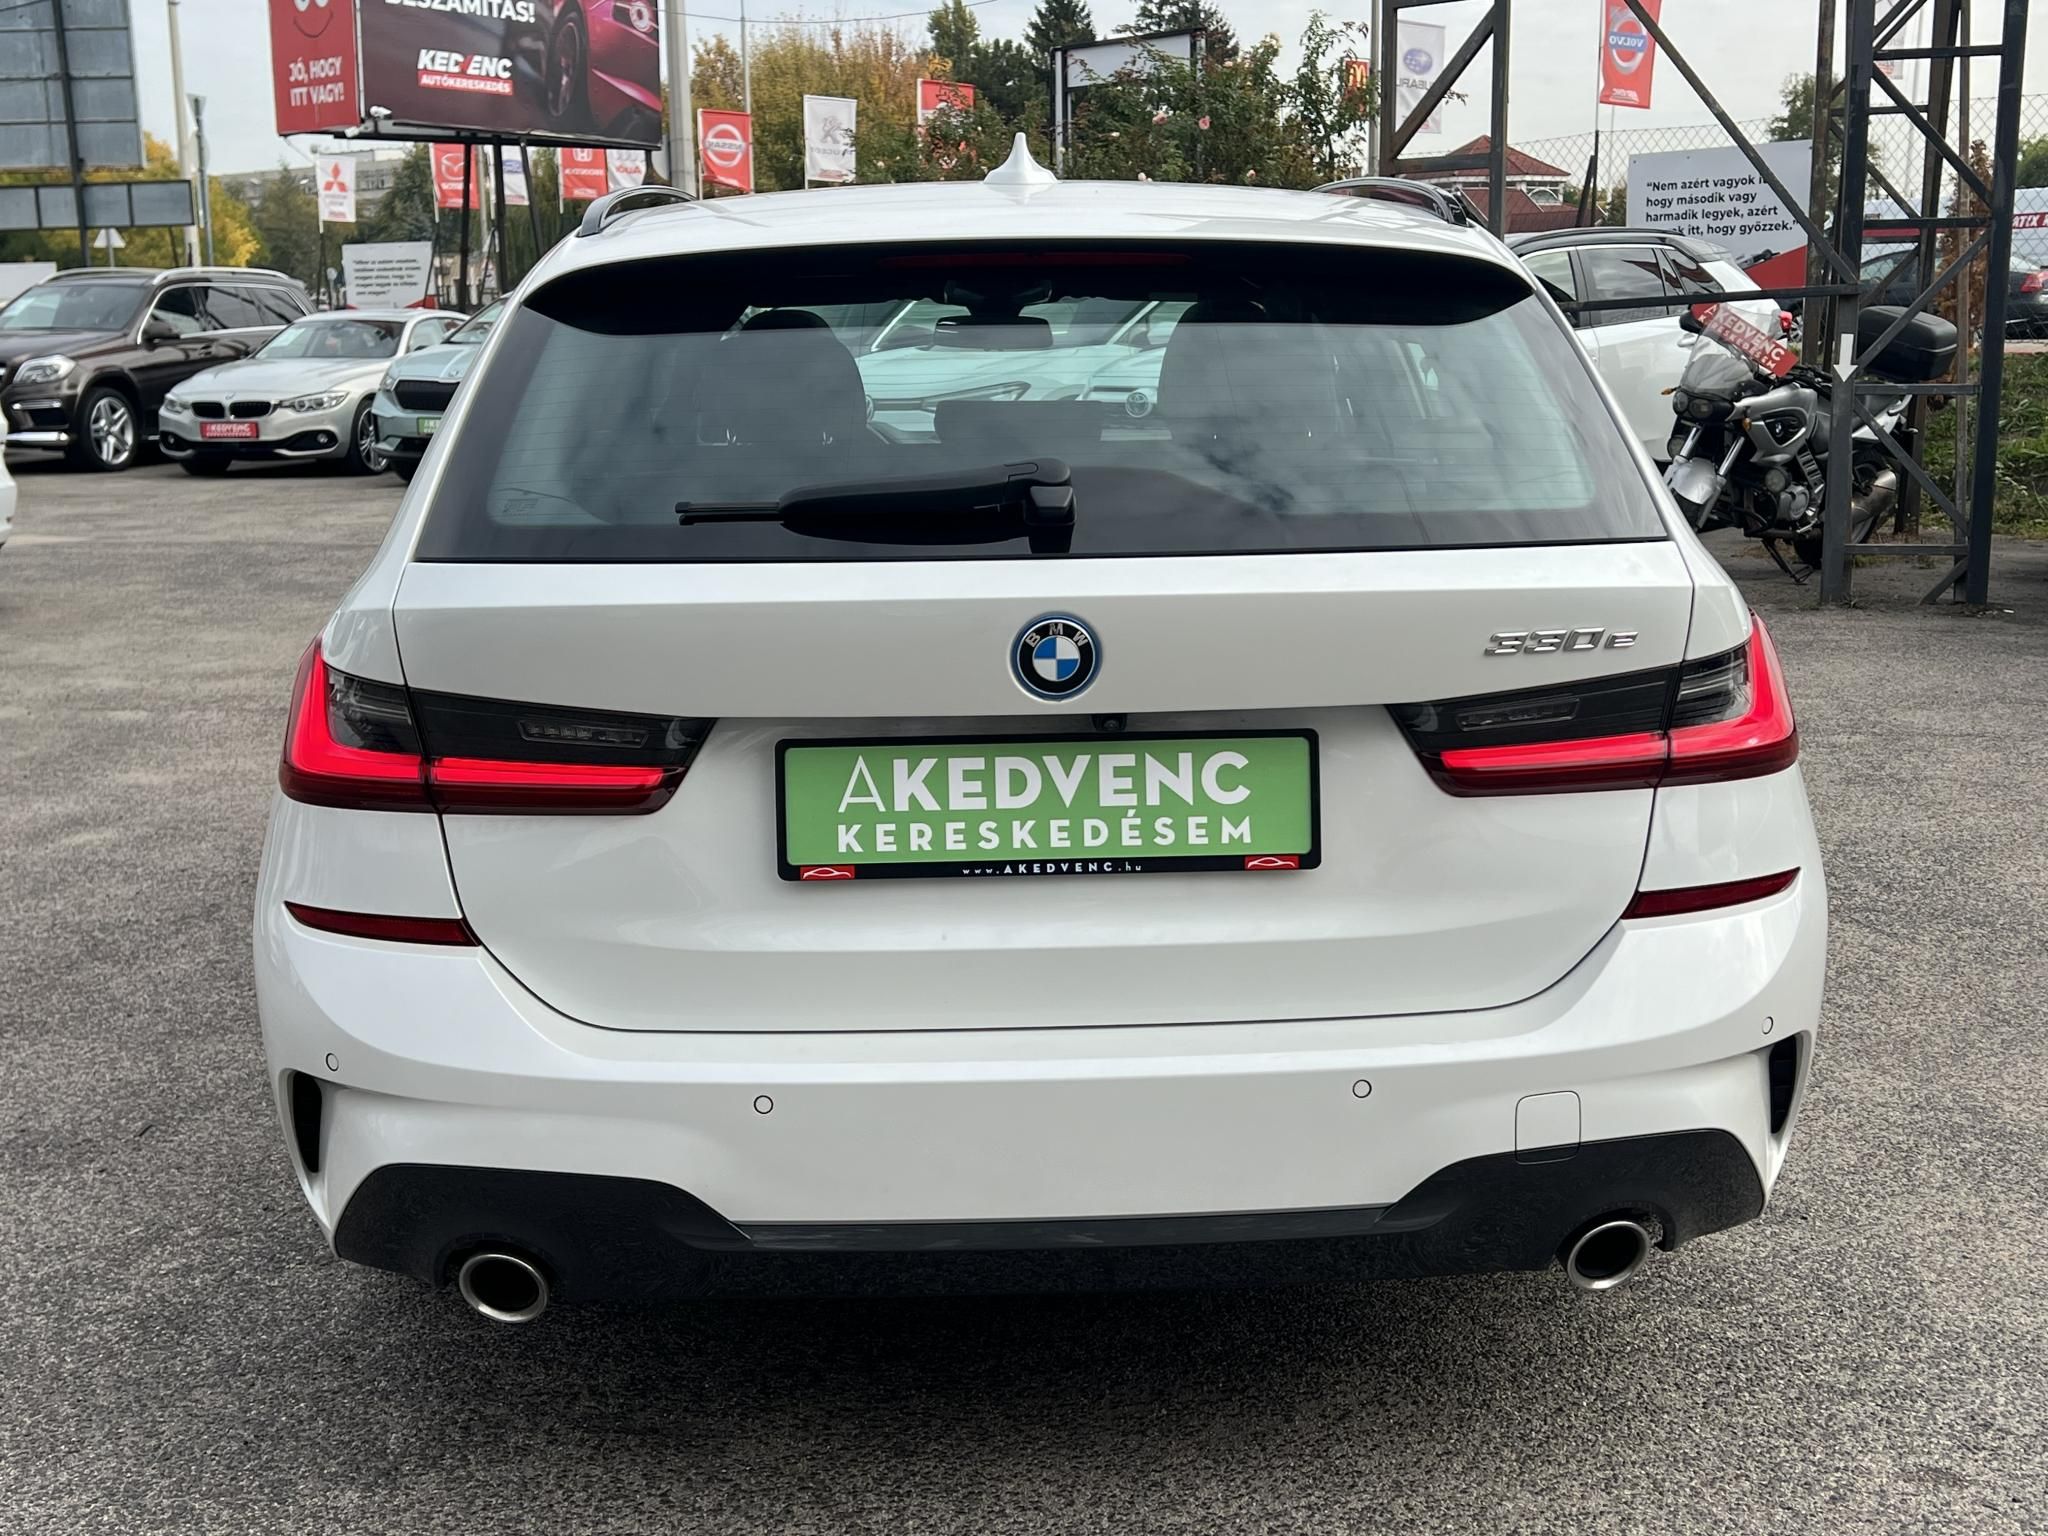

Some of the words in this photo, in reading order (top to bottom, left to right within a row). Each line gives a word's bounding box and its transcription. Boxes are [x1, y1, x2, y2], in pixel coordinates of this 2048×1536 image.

[289, 57, 308, 84] JÓ,
[309, 56, 342, 80] HOGY
[290, 87, 308, 107] ITT
[309, 82, 344, 104] VAGY!
[421, 75, 511, 93] AUTÓKERESKEDÉS
[1681, 179, 1709, 190] azért
[1713, 174, 1755, 189] vagyok
[1646, 196, 1673, 209] hogy
[1676, 192, 1725, 206] második
[1729, 192, 1757, 204] vagy
[1646, 208, 1698, 222] harmadik
[1702, 206, 1744, 222] legyek,
[1747, 206, 1778, 217] azért
[1688, 225, 1704, 236] itt,
[1707, 223, 1736, 236] hogy
[1025, 622, 1089, 648] BMW
[838, 751, 1252, 814] AKEDVENC
[837, 808, 1252, 854] KERESKEDÉSEM
